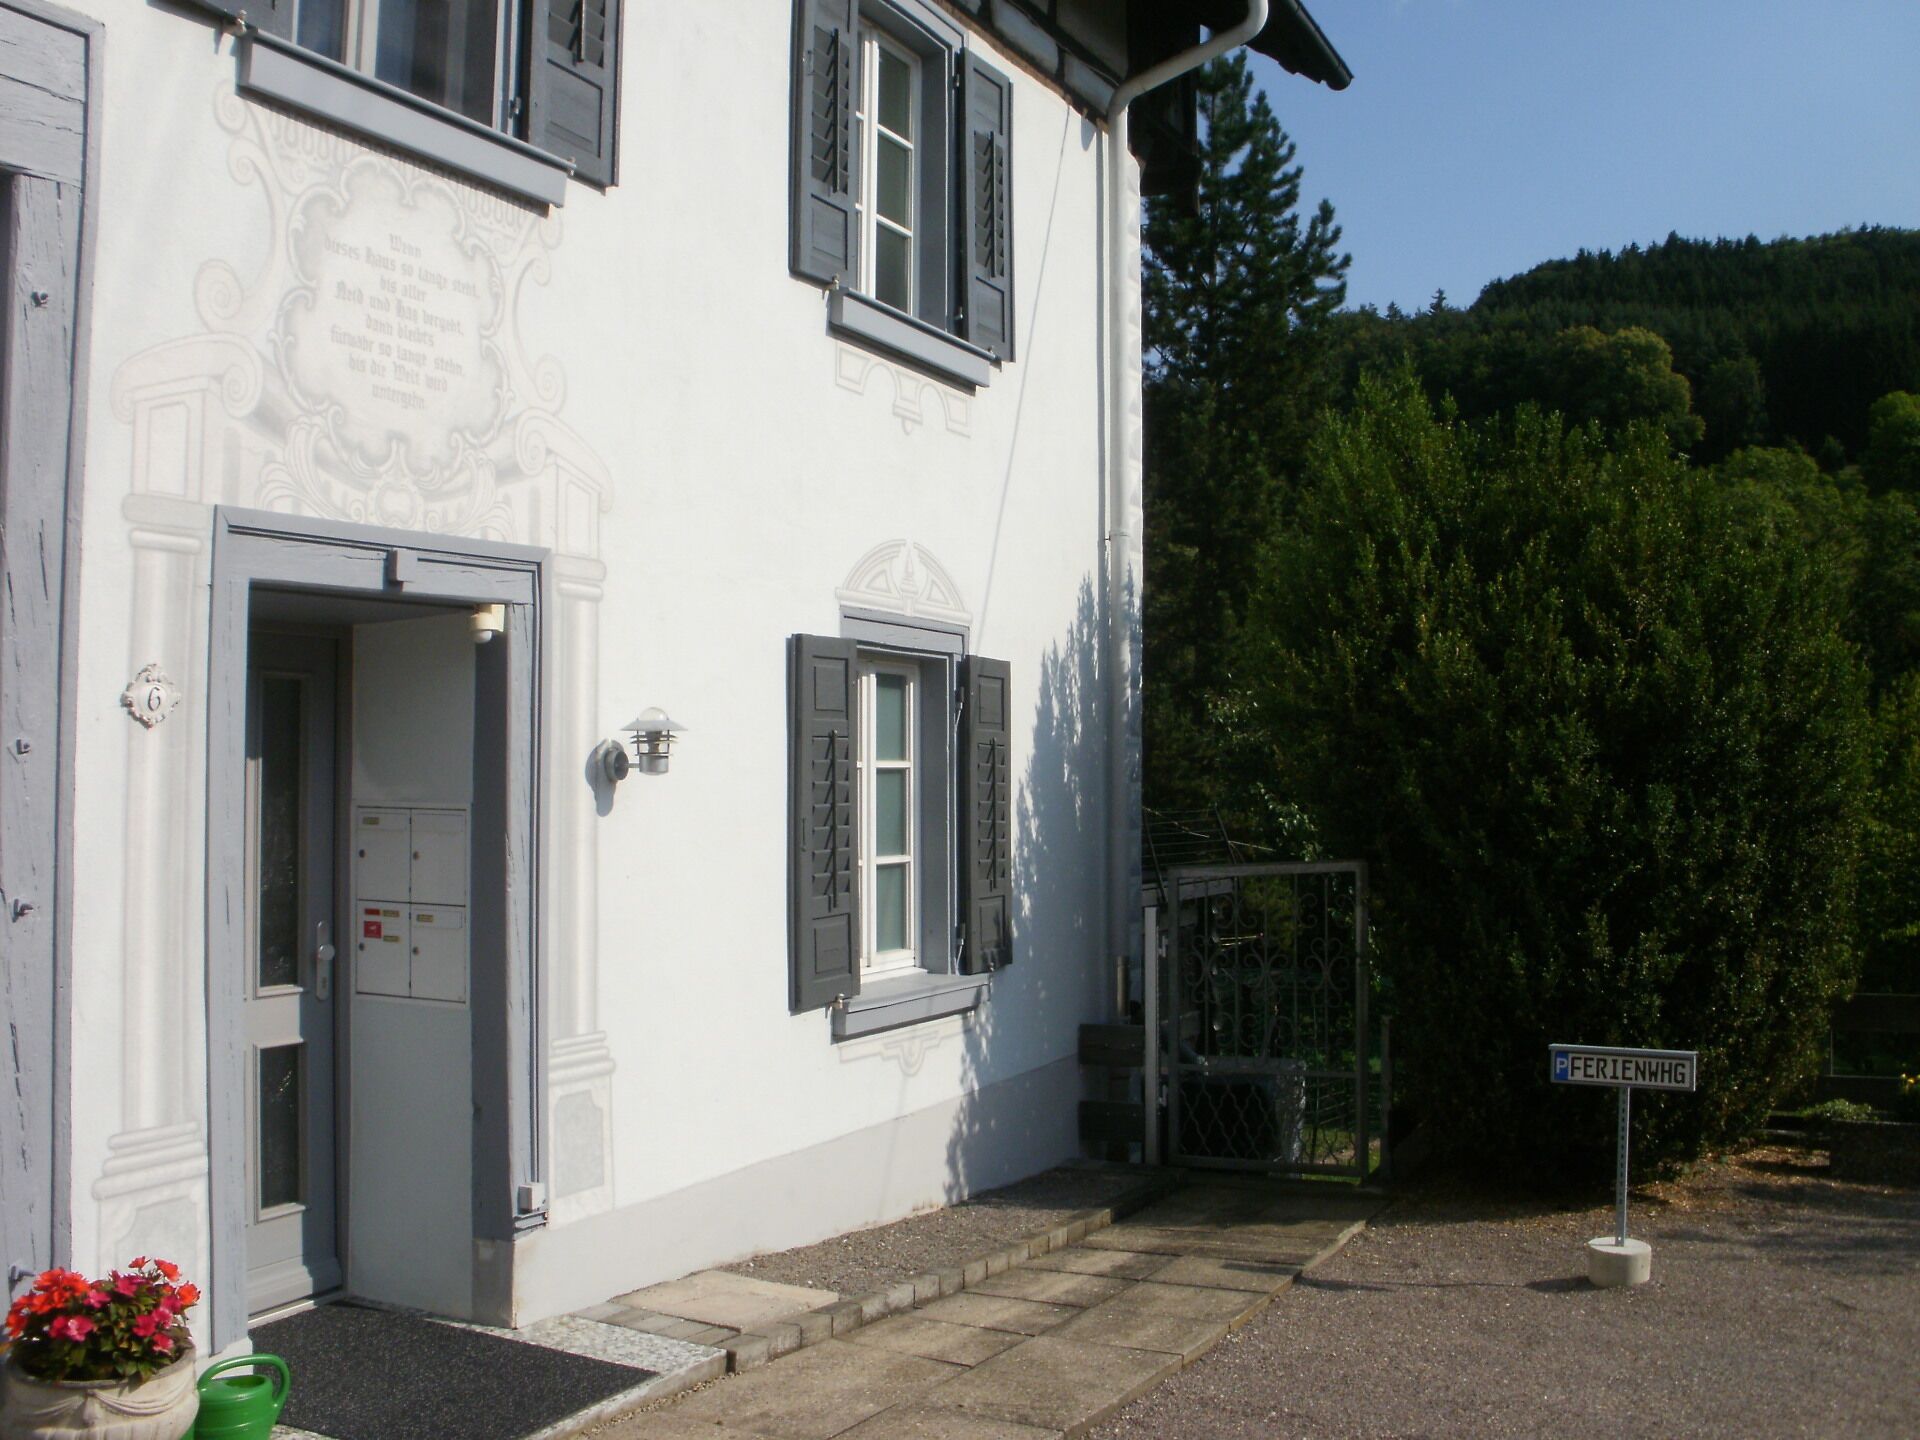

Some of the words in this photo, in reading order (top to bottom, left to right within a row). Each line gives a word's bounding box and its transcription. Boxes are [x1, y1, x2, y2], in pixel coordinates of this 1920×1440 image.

[389, 232, 422, 259] Wenn
[324, 234, 361, 261] dieses
[365, 246, 397, 272] Haus
[401, 263, 414, 277] so
[418, 266, 447, 291] lange
[334, 280, 364, 305] Neid
[369, 295, 391, 312] und
[380, 275, 397, 294] bis
[401, 284, 427, 303] aller
[365, 313, 393, 336] dann
[378, 341, 392, 357] so
[396, 345, 427, 368] lange
[349, 353, 367, 373] bis
[370, 359, 387, 378] die
[393, 361, 420, 386] Welt
[425, 373, 448, 393] wird
[147, 686, 161, 712] 6
[1556, 1058, 1567, 1074] P
[1570, 1056, 1686, 1084] FERIENWHG
